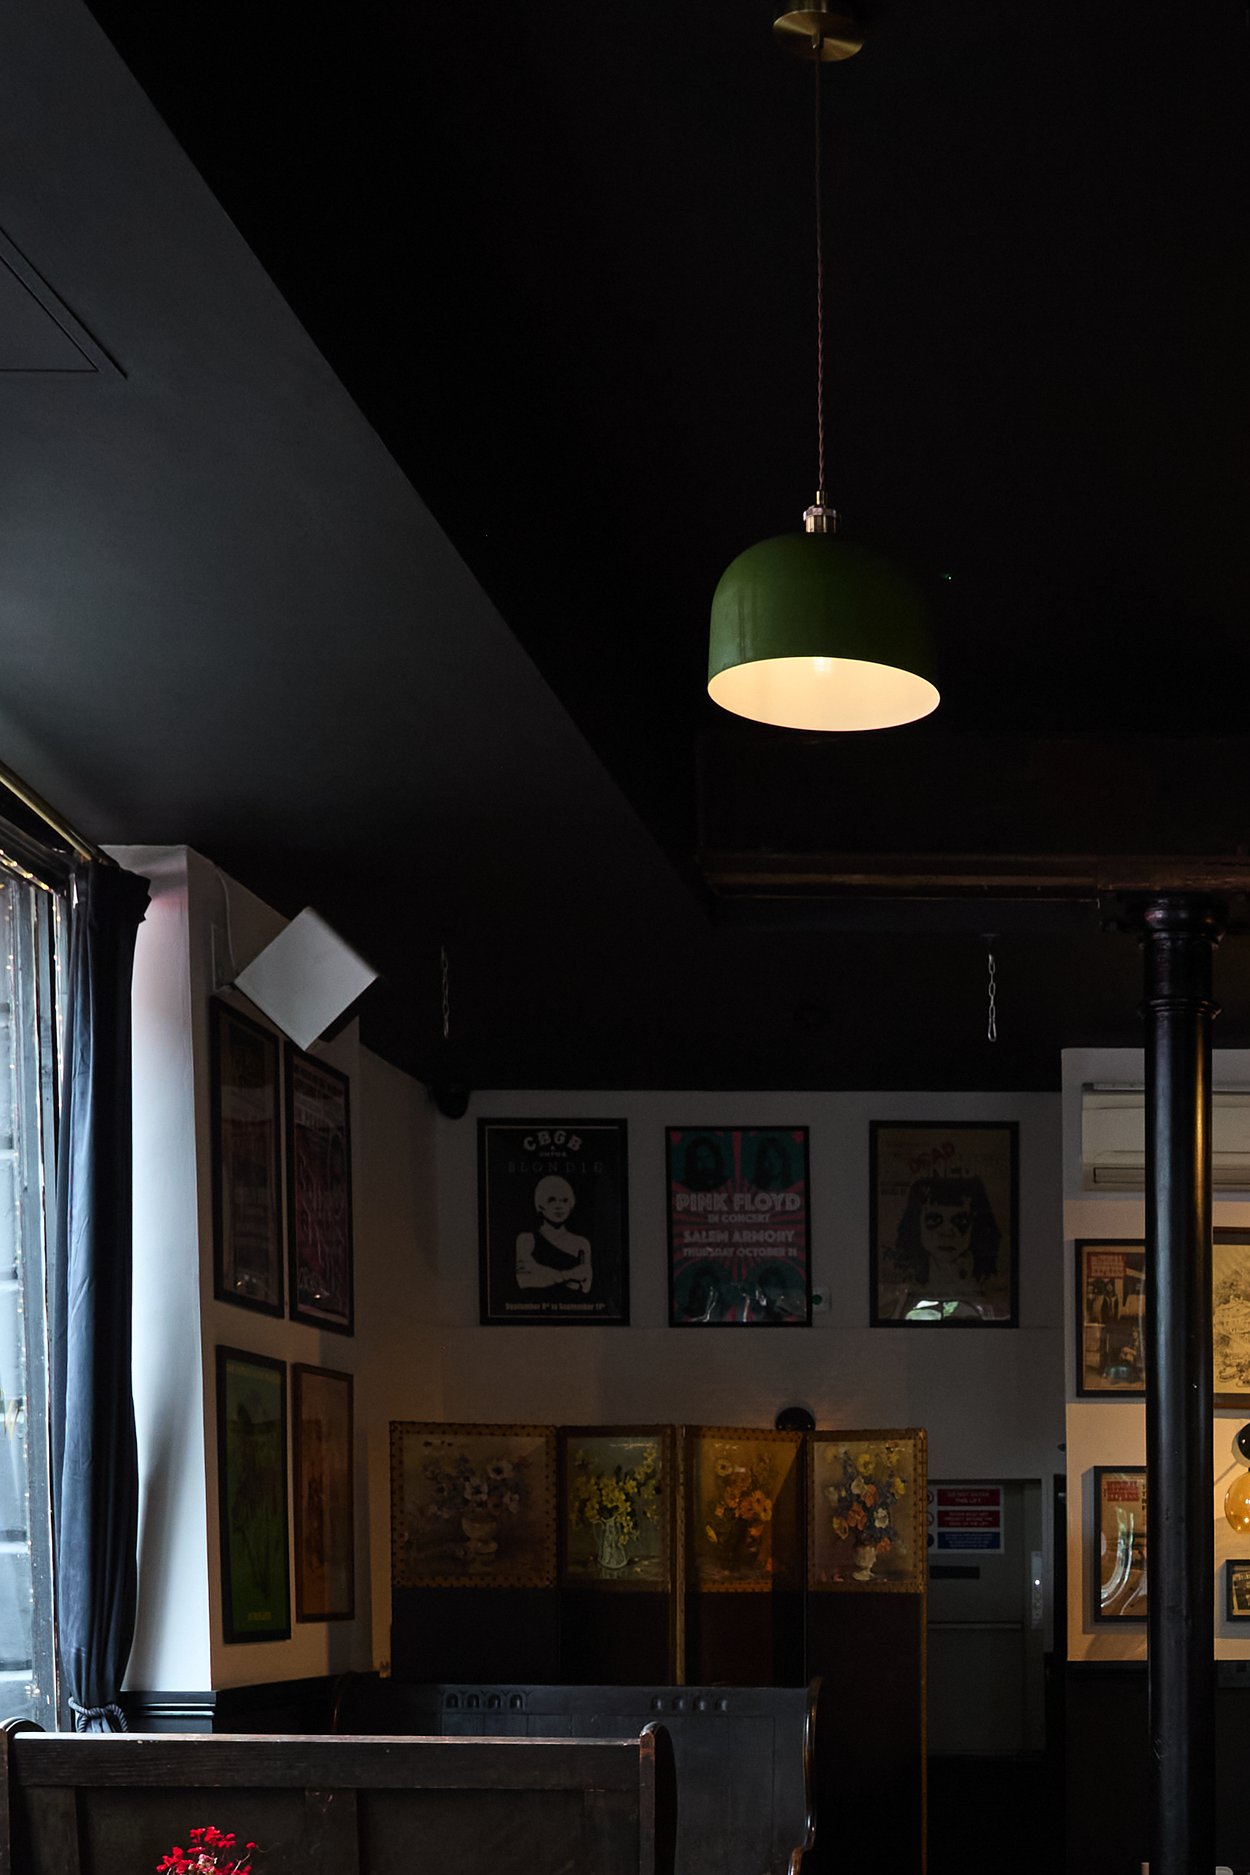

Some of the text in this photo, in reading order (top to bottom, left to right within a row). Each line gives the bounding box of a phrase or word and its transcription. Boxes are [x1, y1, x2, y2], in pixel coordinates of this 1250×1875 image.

[523, 1130, 582, 1152] CBGB
[507, 1161, 603, 1174] BLONDIE
[675, 1192, 800, 1212] PINK FLOYD
[707, 1213, 770, 1223] IN CONCERT
[683, 1229, 796, 1243] SALEM ARMORY
[683, 1247, 735, 1257] THURSDAY
[736, 1247, 786, 1258] OCTOBER
